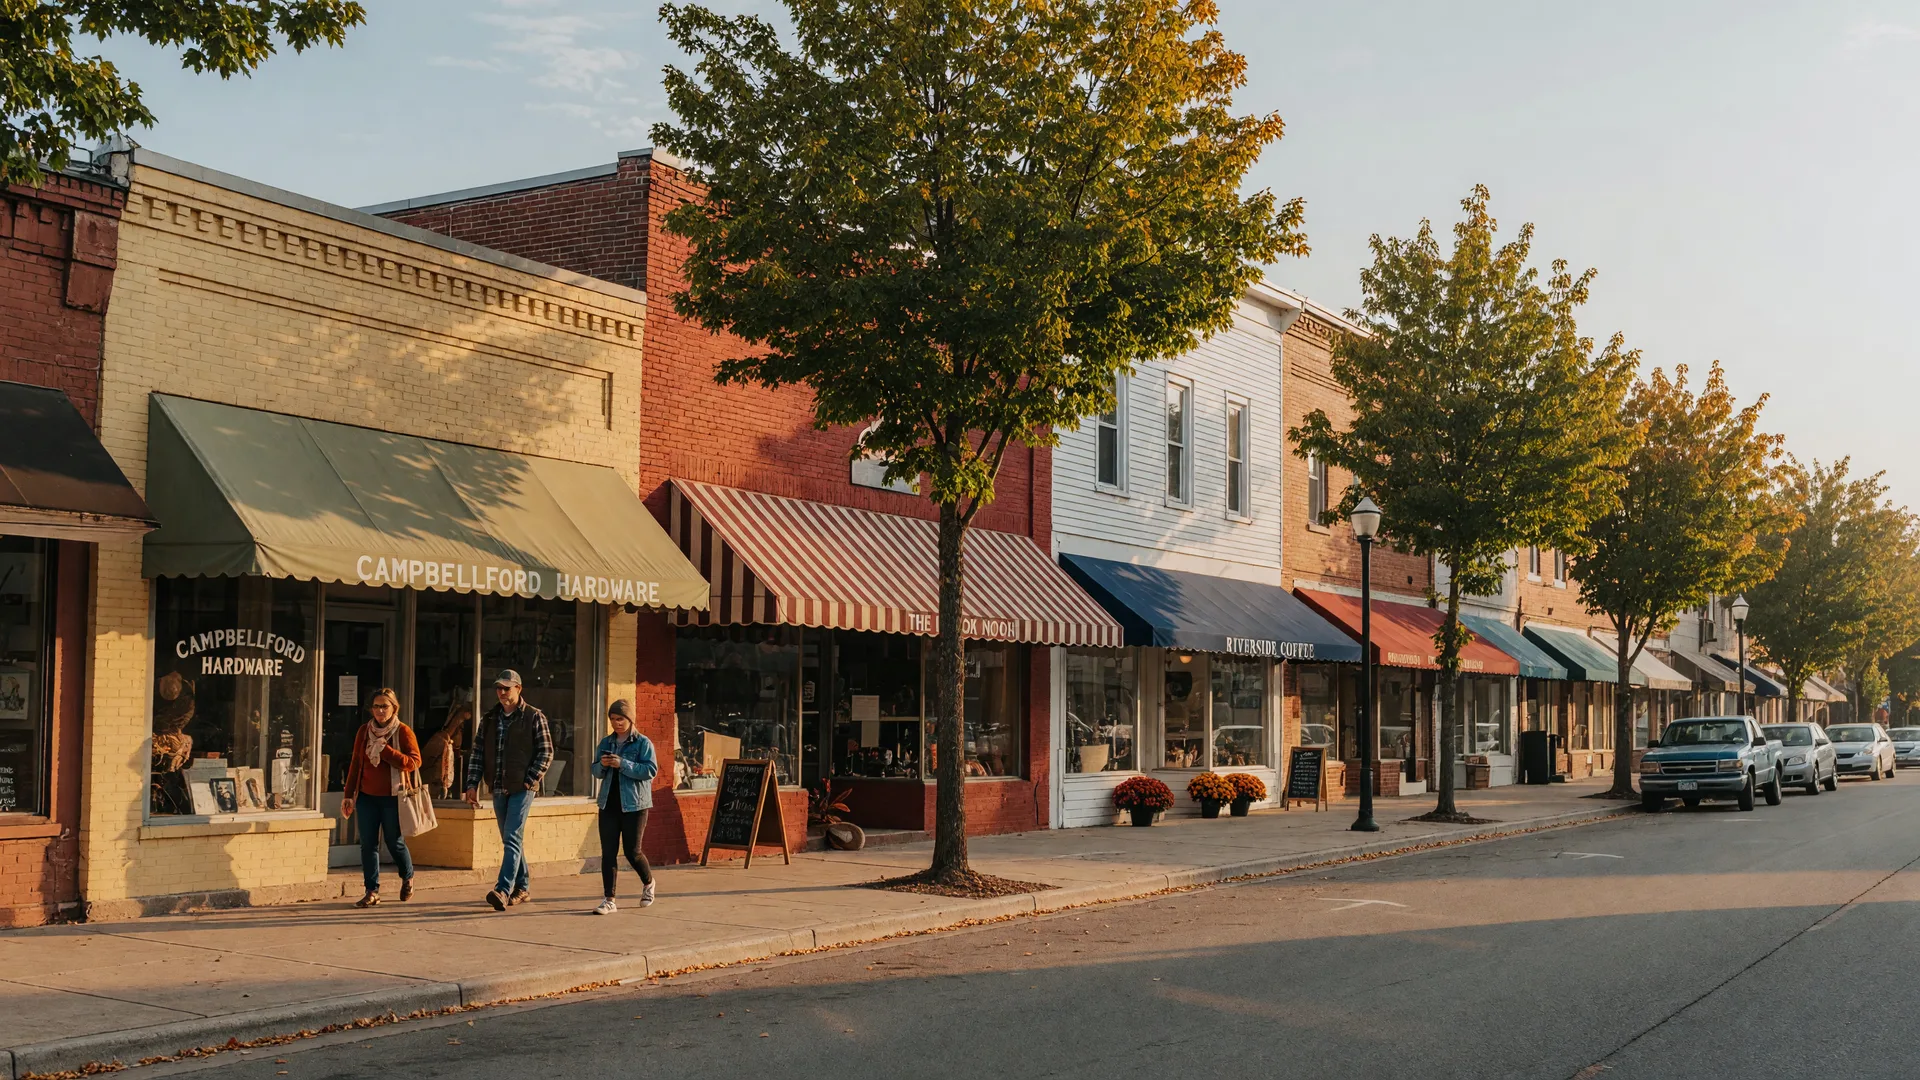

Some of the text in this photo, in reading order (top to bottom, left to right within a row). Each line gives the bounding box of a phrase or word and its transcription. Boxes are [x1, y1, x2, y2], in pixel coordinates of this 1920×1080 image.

[356, 555, 660, 603] CAMPBELLFORD HARDWARE
[908, 613, 932, 632] THE
[175, 628, 306, 664] CAMPBELLFORD
[1226, 636, 1277, 656] RIVERSIDE
[201, 656, 284, 677] HARDWARE
